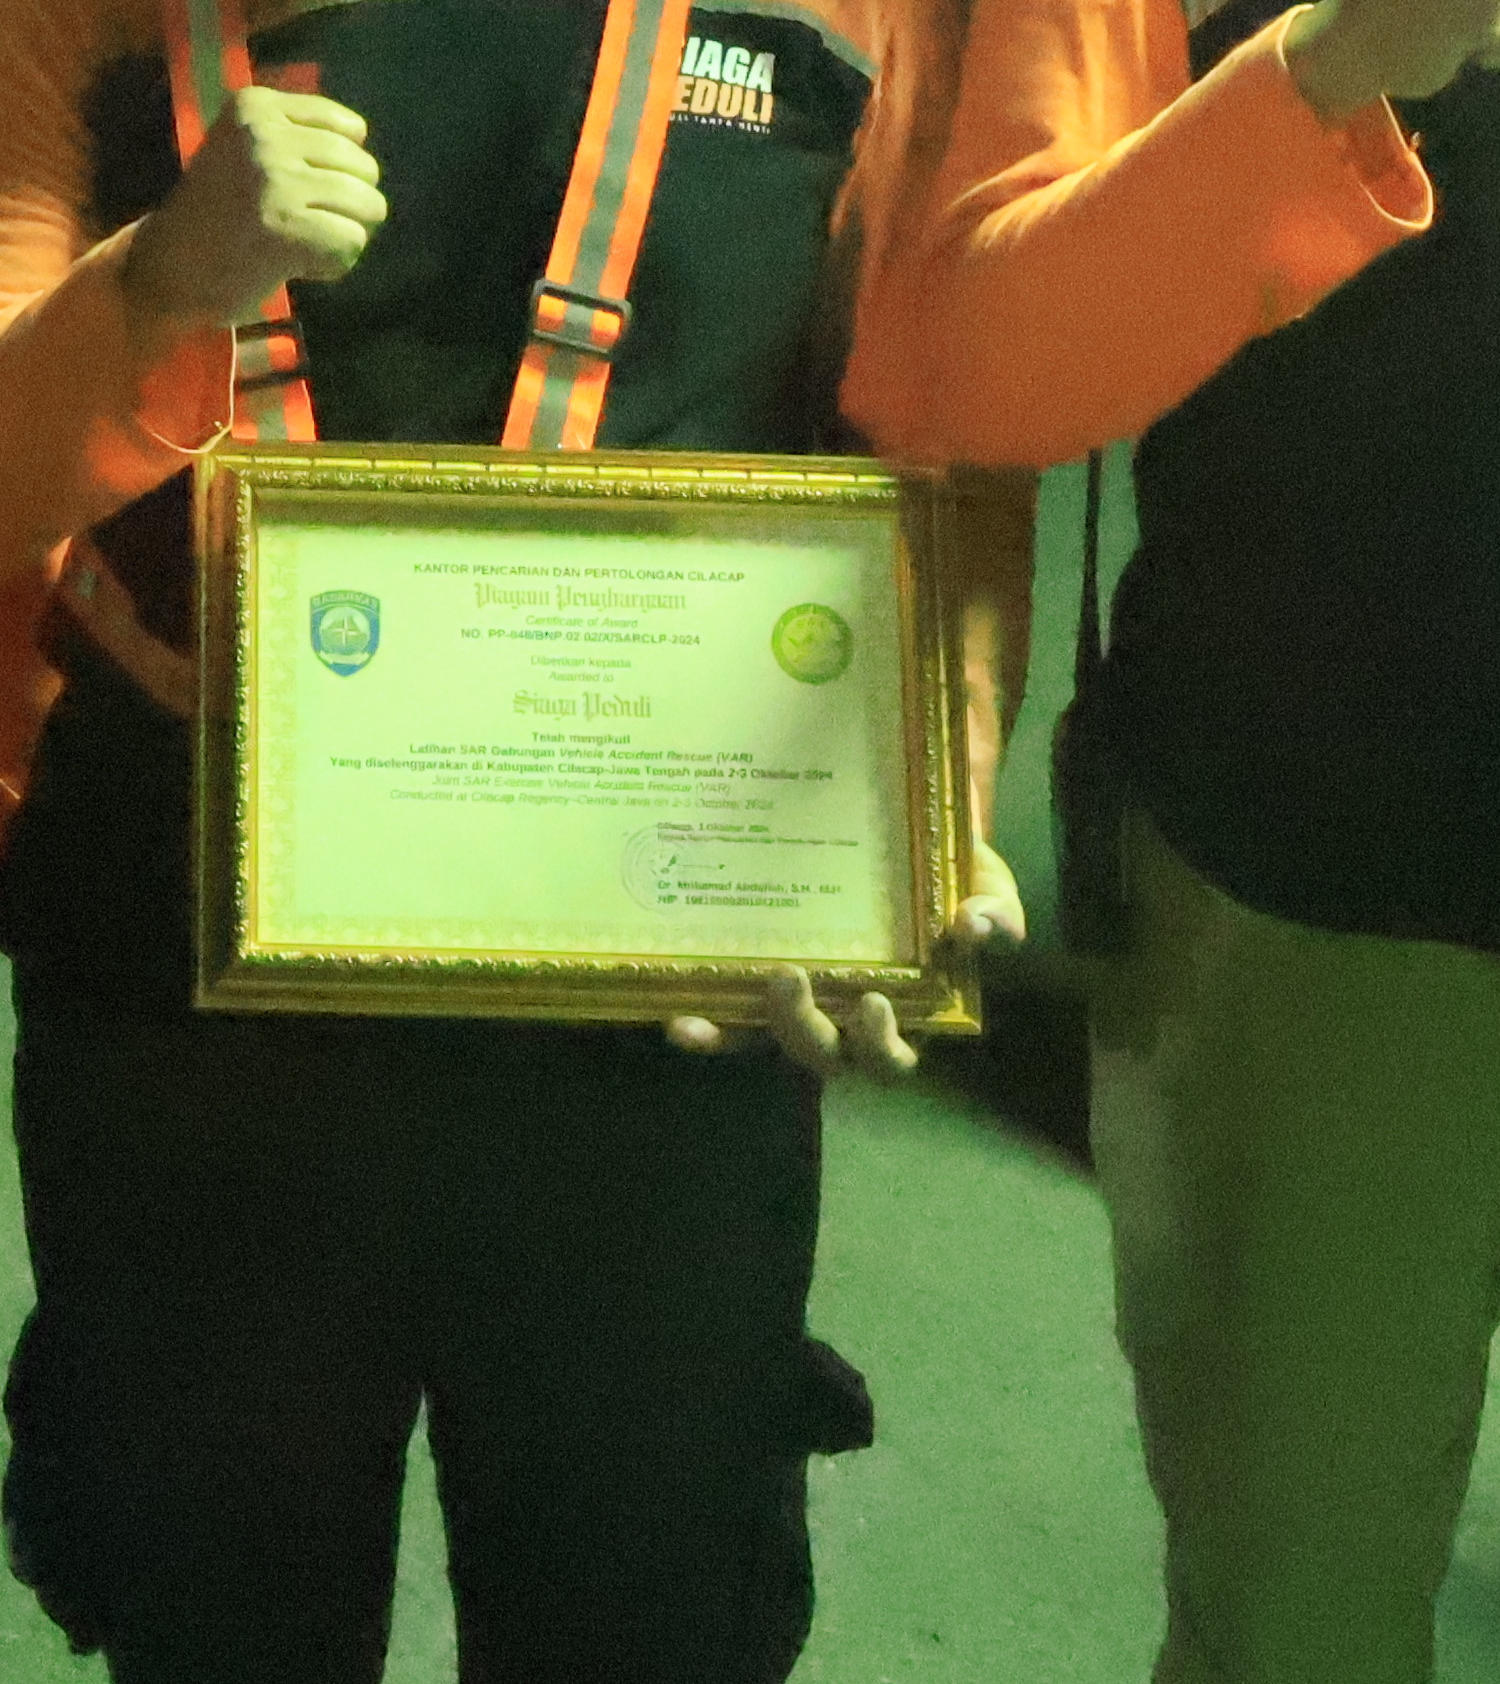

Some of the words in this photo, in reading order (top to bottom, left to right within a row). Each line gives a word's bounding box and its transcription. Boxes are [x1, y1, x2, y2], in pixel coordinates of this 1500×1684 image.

[680, 36, 776, 93] IAGA
[669, 75, 774, 124] EDULI
[413, 563, 469, 574] KANTOR
[473, 564, 549, 577] PENCARIAN
[552, 567, 580, 578] DAN
[584, 568, 684, 580] PERTOLONGAN
[687, 571, 746, 582] CILACAP
[525, 615, 583, 628] Certificate
[602, 617, 639, 628] Award
[588, 657, 632, 669] kepada
[512, 689, 577, 721] Siaga
[582, 691, 652, 722] Peduli
[459, 745, 487, 756] SAR
[330, 757, 362, 768] Yang
[365, 757, 468, 771] diselenggarakan
[472, 760, 483, 771] di
